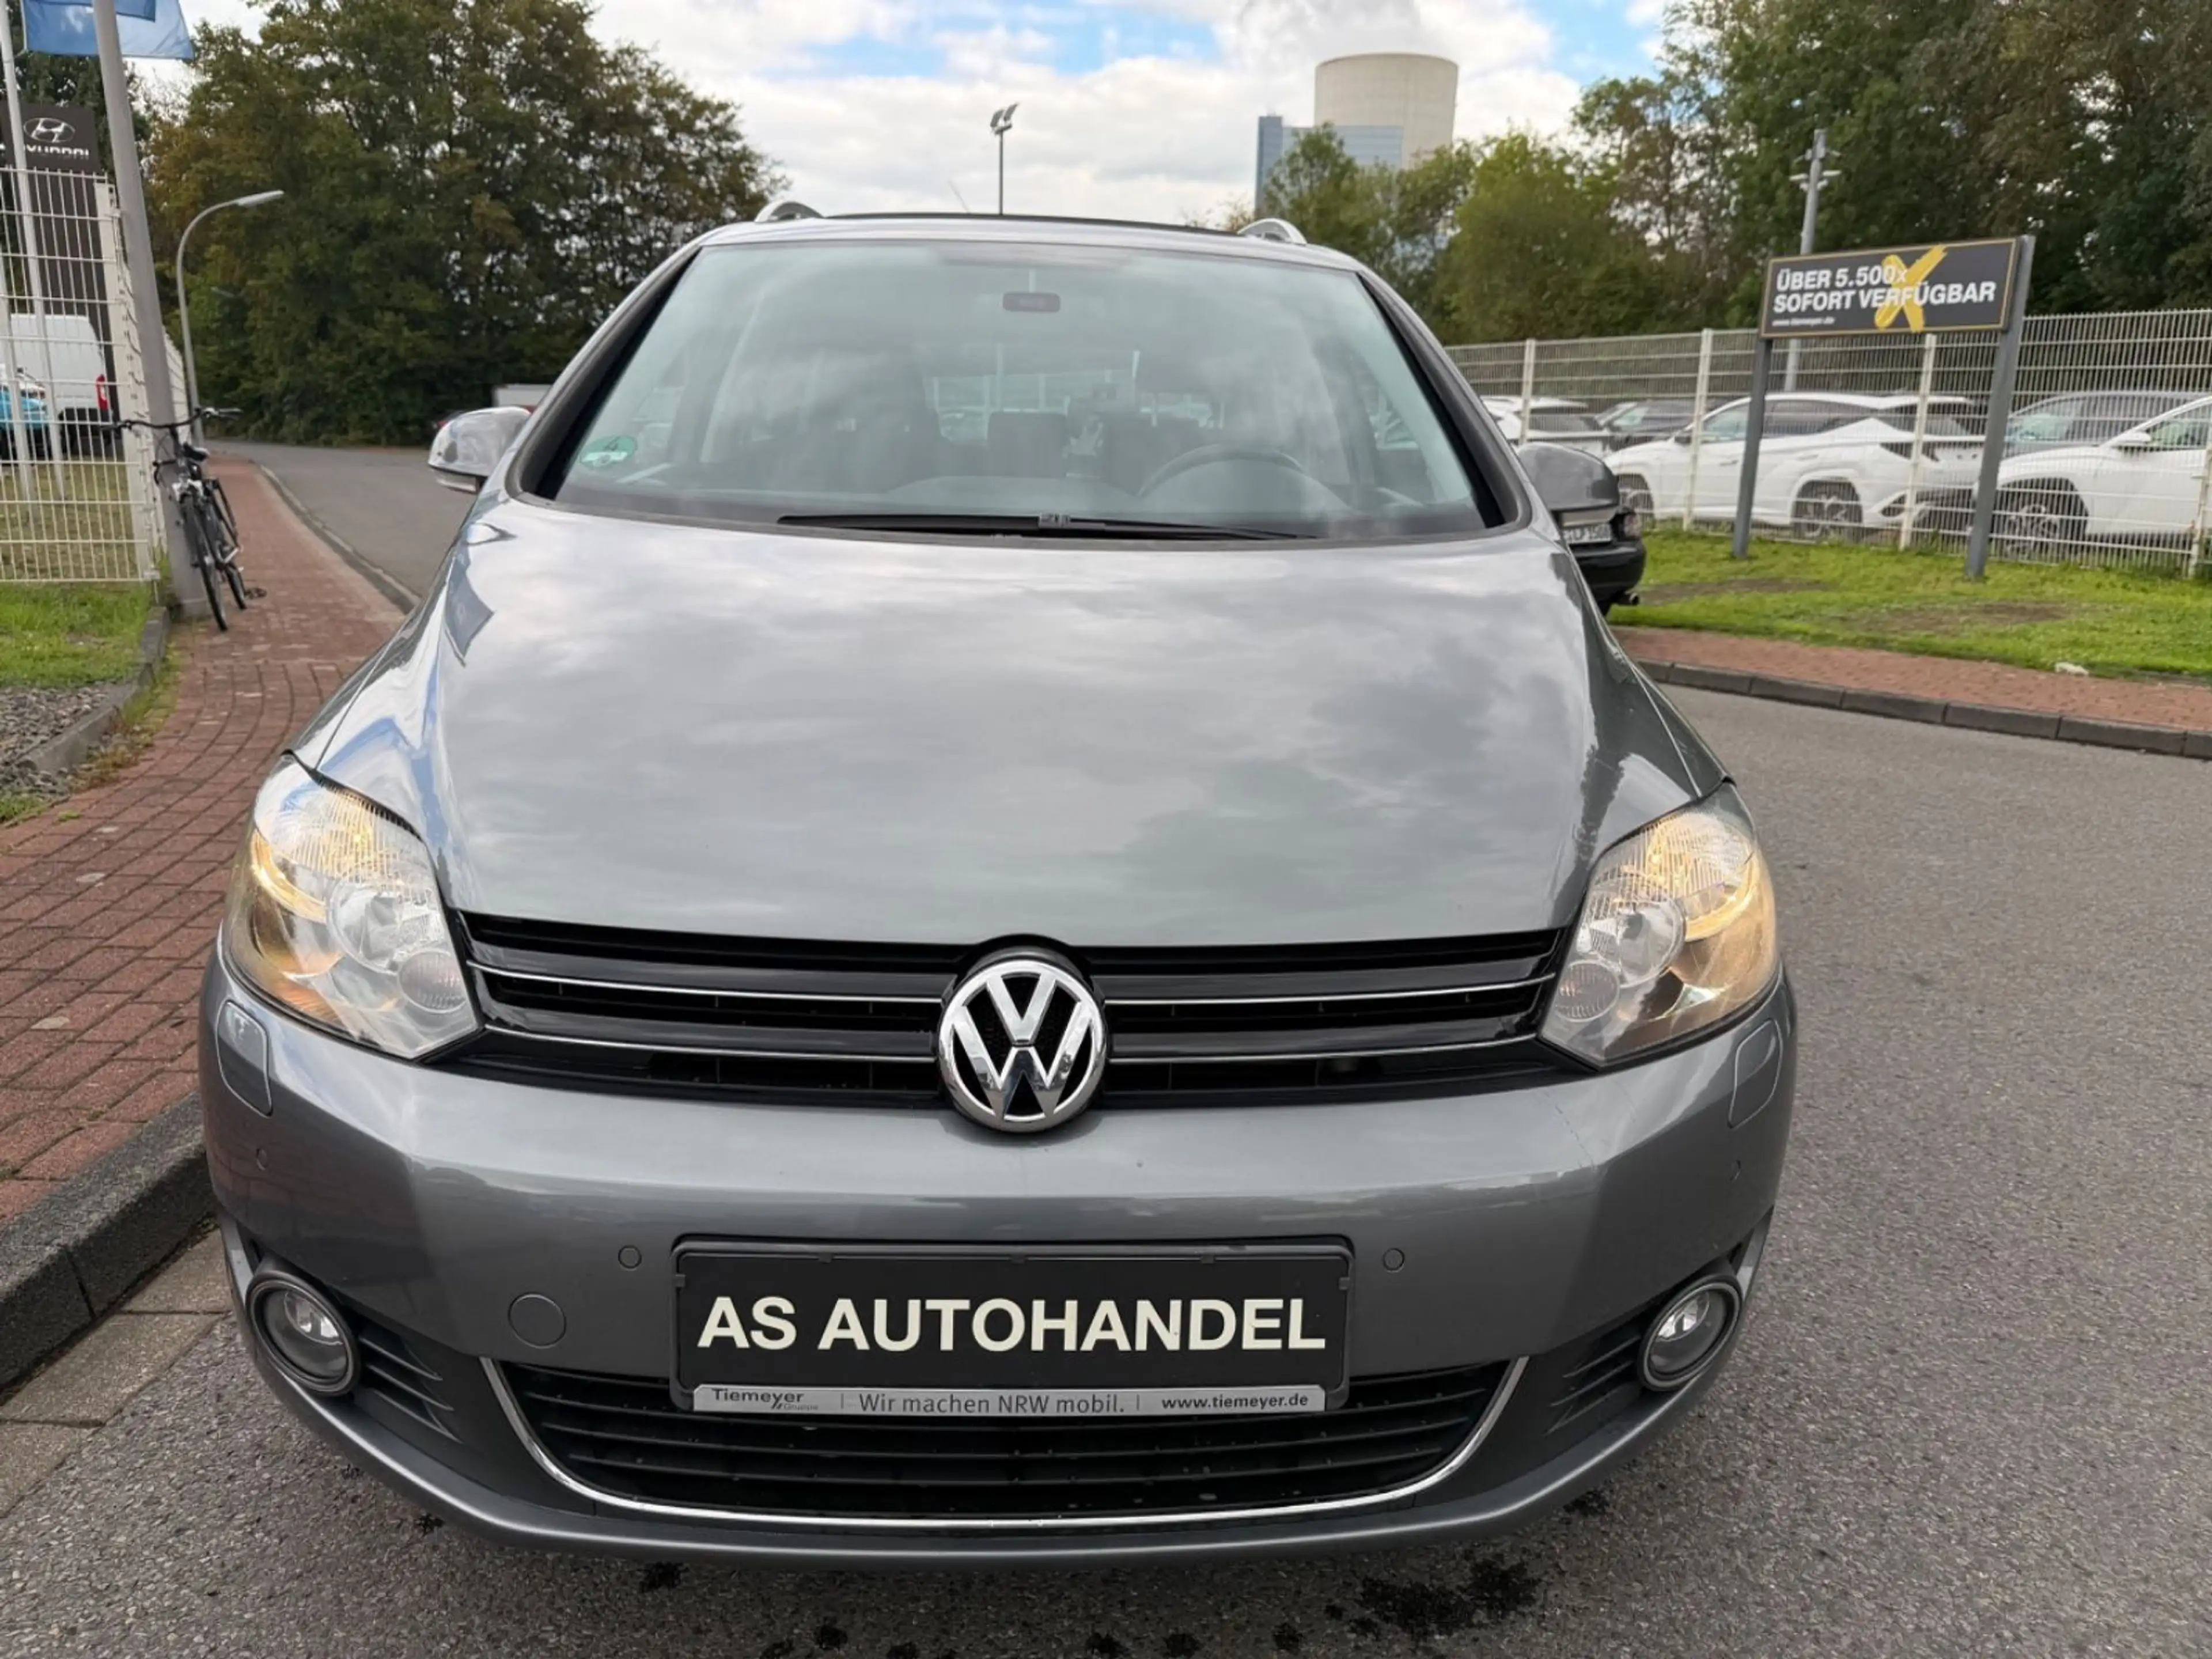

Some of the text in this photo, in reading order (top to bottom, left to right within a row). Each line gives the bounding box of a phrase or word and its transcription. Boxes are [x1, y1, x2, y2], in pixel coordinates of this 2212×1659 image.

[1777, 268, 1832, 291] ÜBER
[1773, 281, 1997, 313] SOFORT VERFÜGBAR
[698, 1296, 1325, 1352] AS AUTOHANDEL
[711, 1388, 804, 1410] Tiemeyer
[859, 1393, 1125, 1414] Wir machen NRW mobil.
[1161, 1393, 1309, 1410] www.tiemeyer.de
